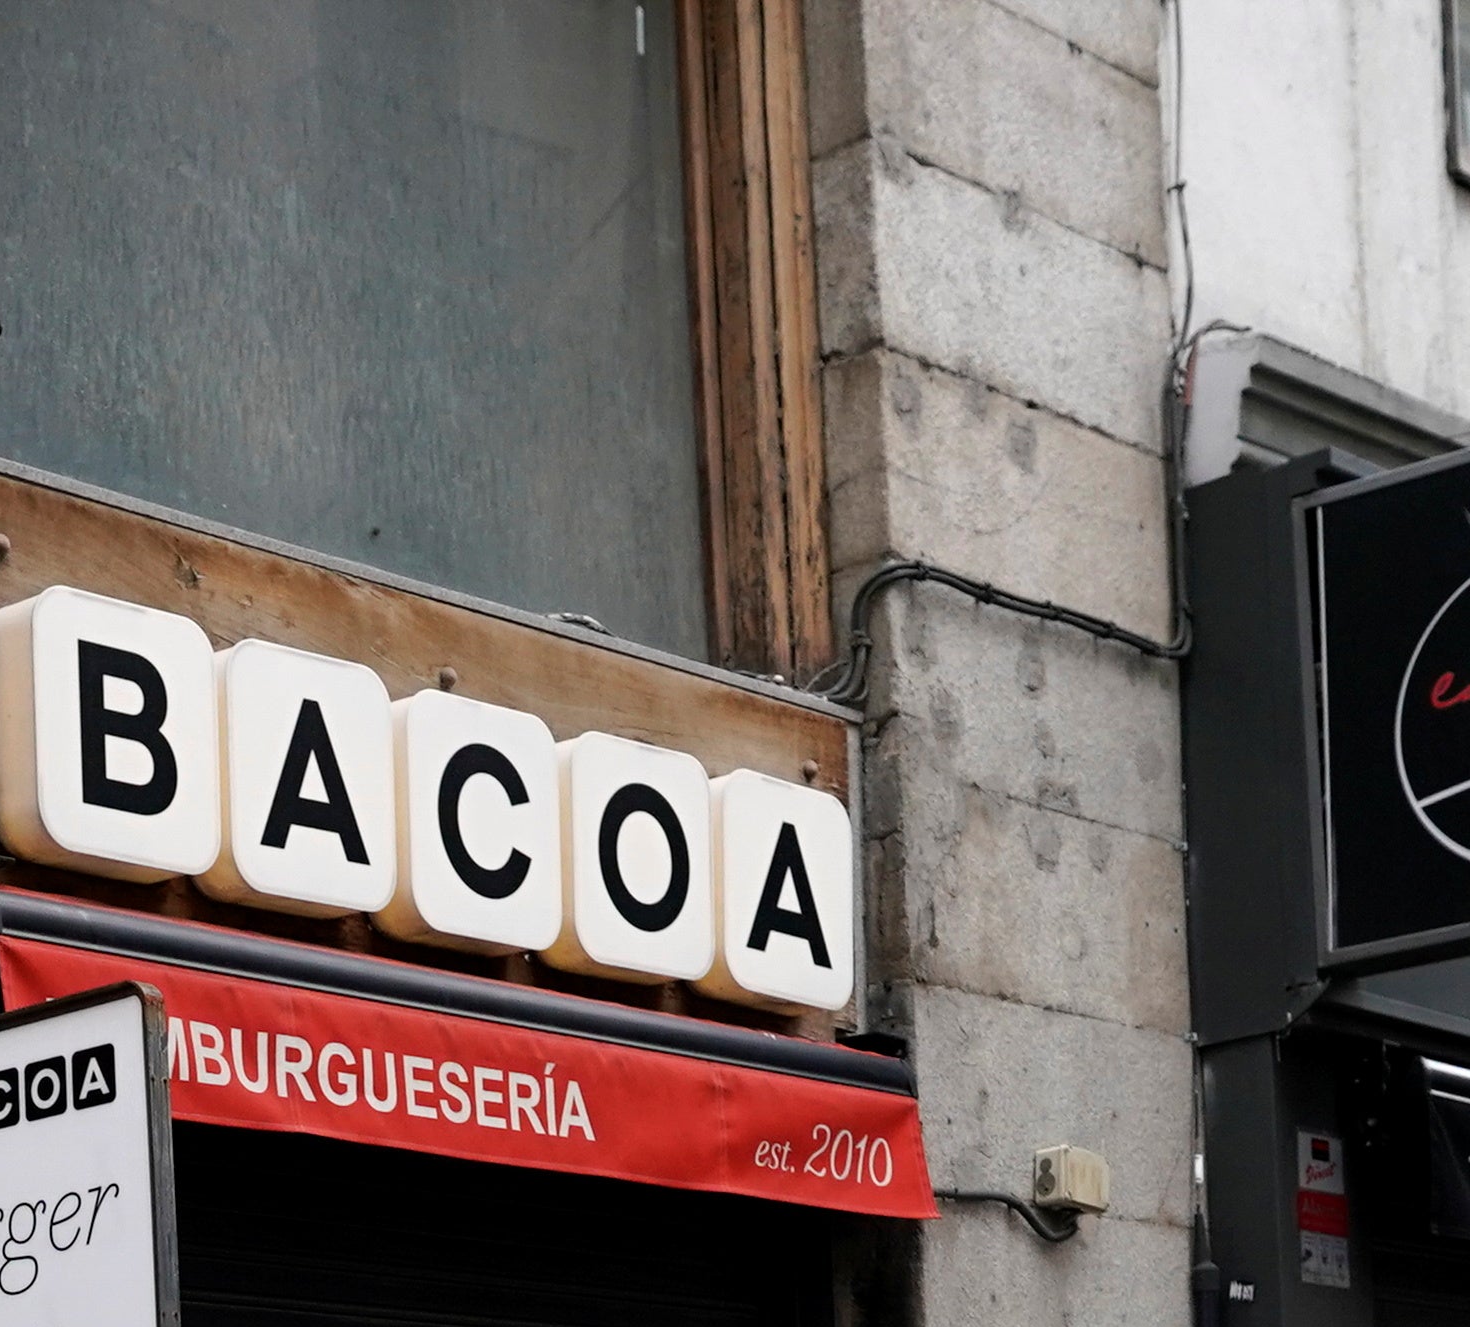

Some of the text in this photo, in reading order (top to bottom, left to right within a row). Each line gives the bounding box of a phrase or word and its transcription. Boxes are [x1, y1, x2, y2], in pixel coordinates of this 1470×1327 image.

[78, 640, 832, 969] BACOA
[166, 1015, 894, 1188] MBURGUESERÍA est. 2010
